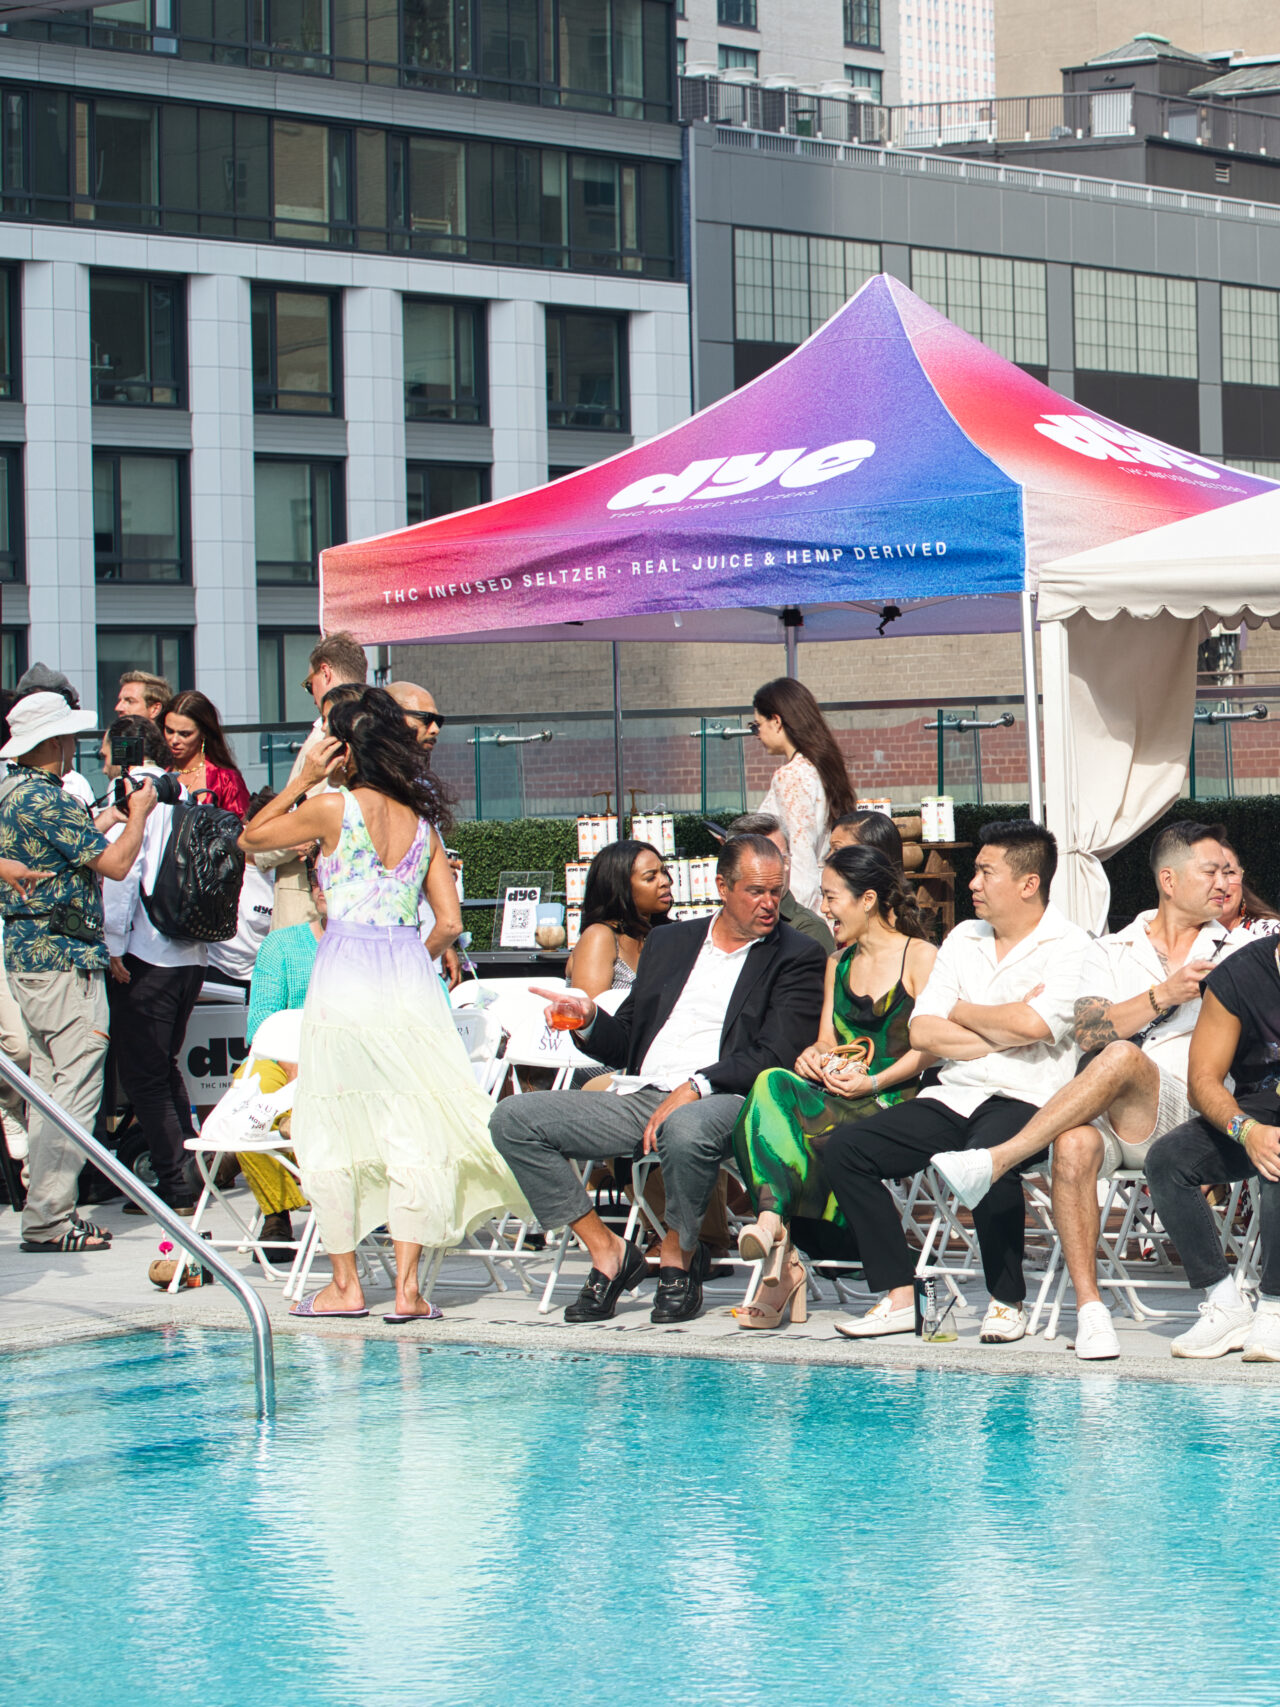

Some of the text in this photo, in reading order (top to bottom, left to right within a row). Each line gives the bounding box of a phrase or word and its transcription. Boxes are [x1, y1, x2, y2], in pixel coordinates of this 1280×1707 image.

[606, 439, 877, 511] dye
[648, 500, 727, 516] INFUSED
[730, 489, 819, 505] SELTZERS
[383, 587, 419, 604] THC
[428, 577, 513, 599] INFUSED
[523, 565, 607, 588] SELTZER
[631, 558, 681, 576] REAL
[692, 553, 754, 571] JUICE
[764, 552, 776, 566] &
[787, 548, 844, 565] HEMP
[856, 541, 948, 561] DERIVED
[507, 889, 538, 902] dye
[187, 1037, 251, 1078] dy
[487, 1319, 657, 1335] INCHES
